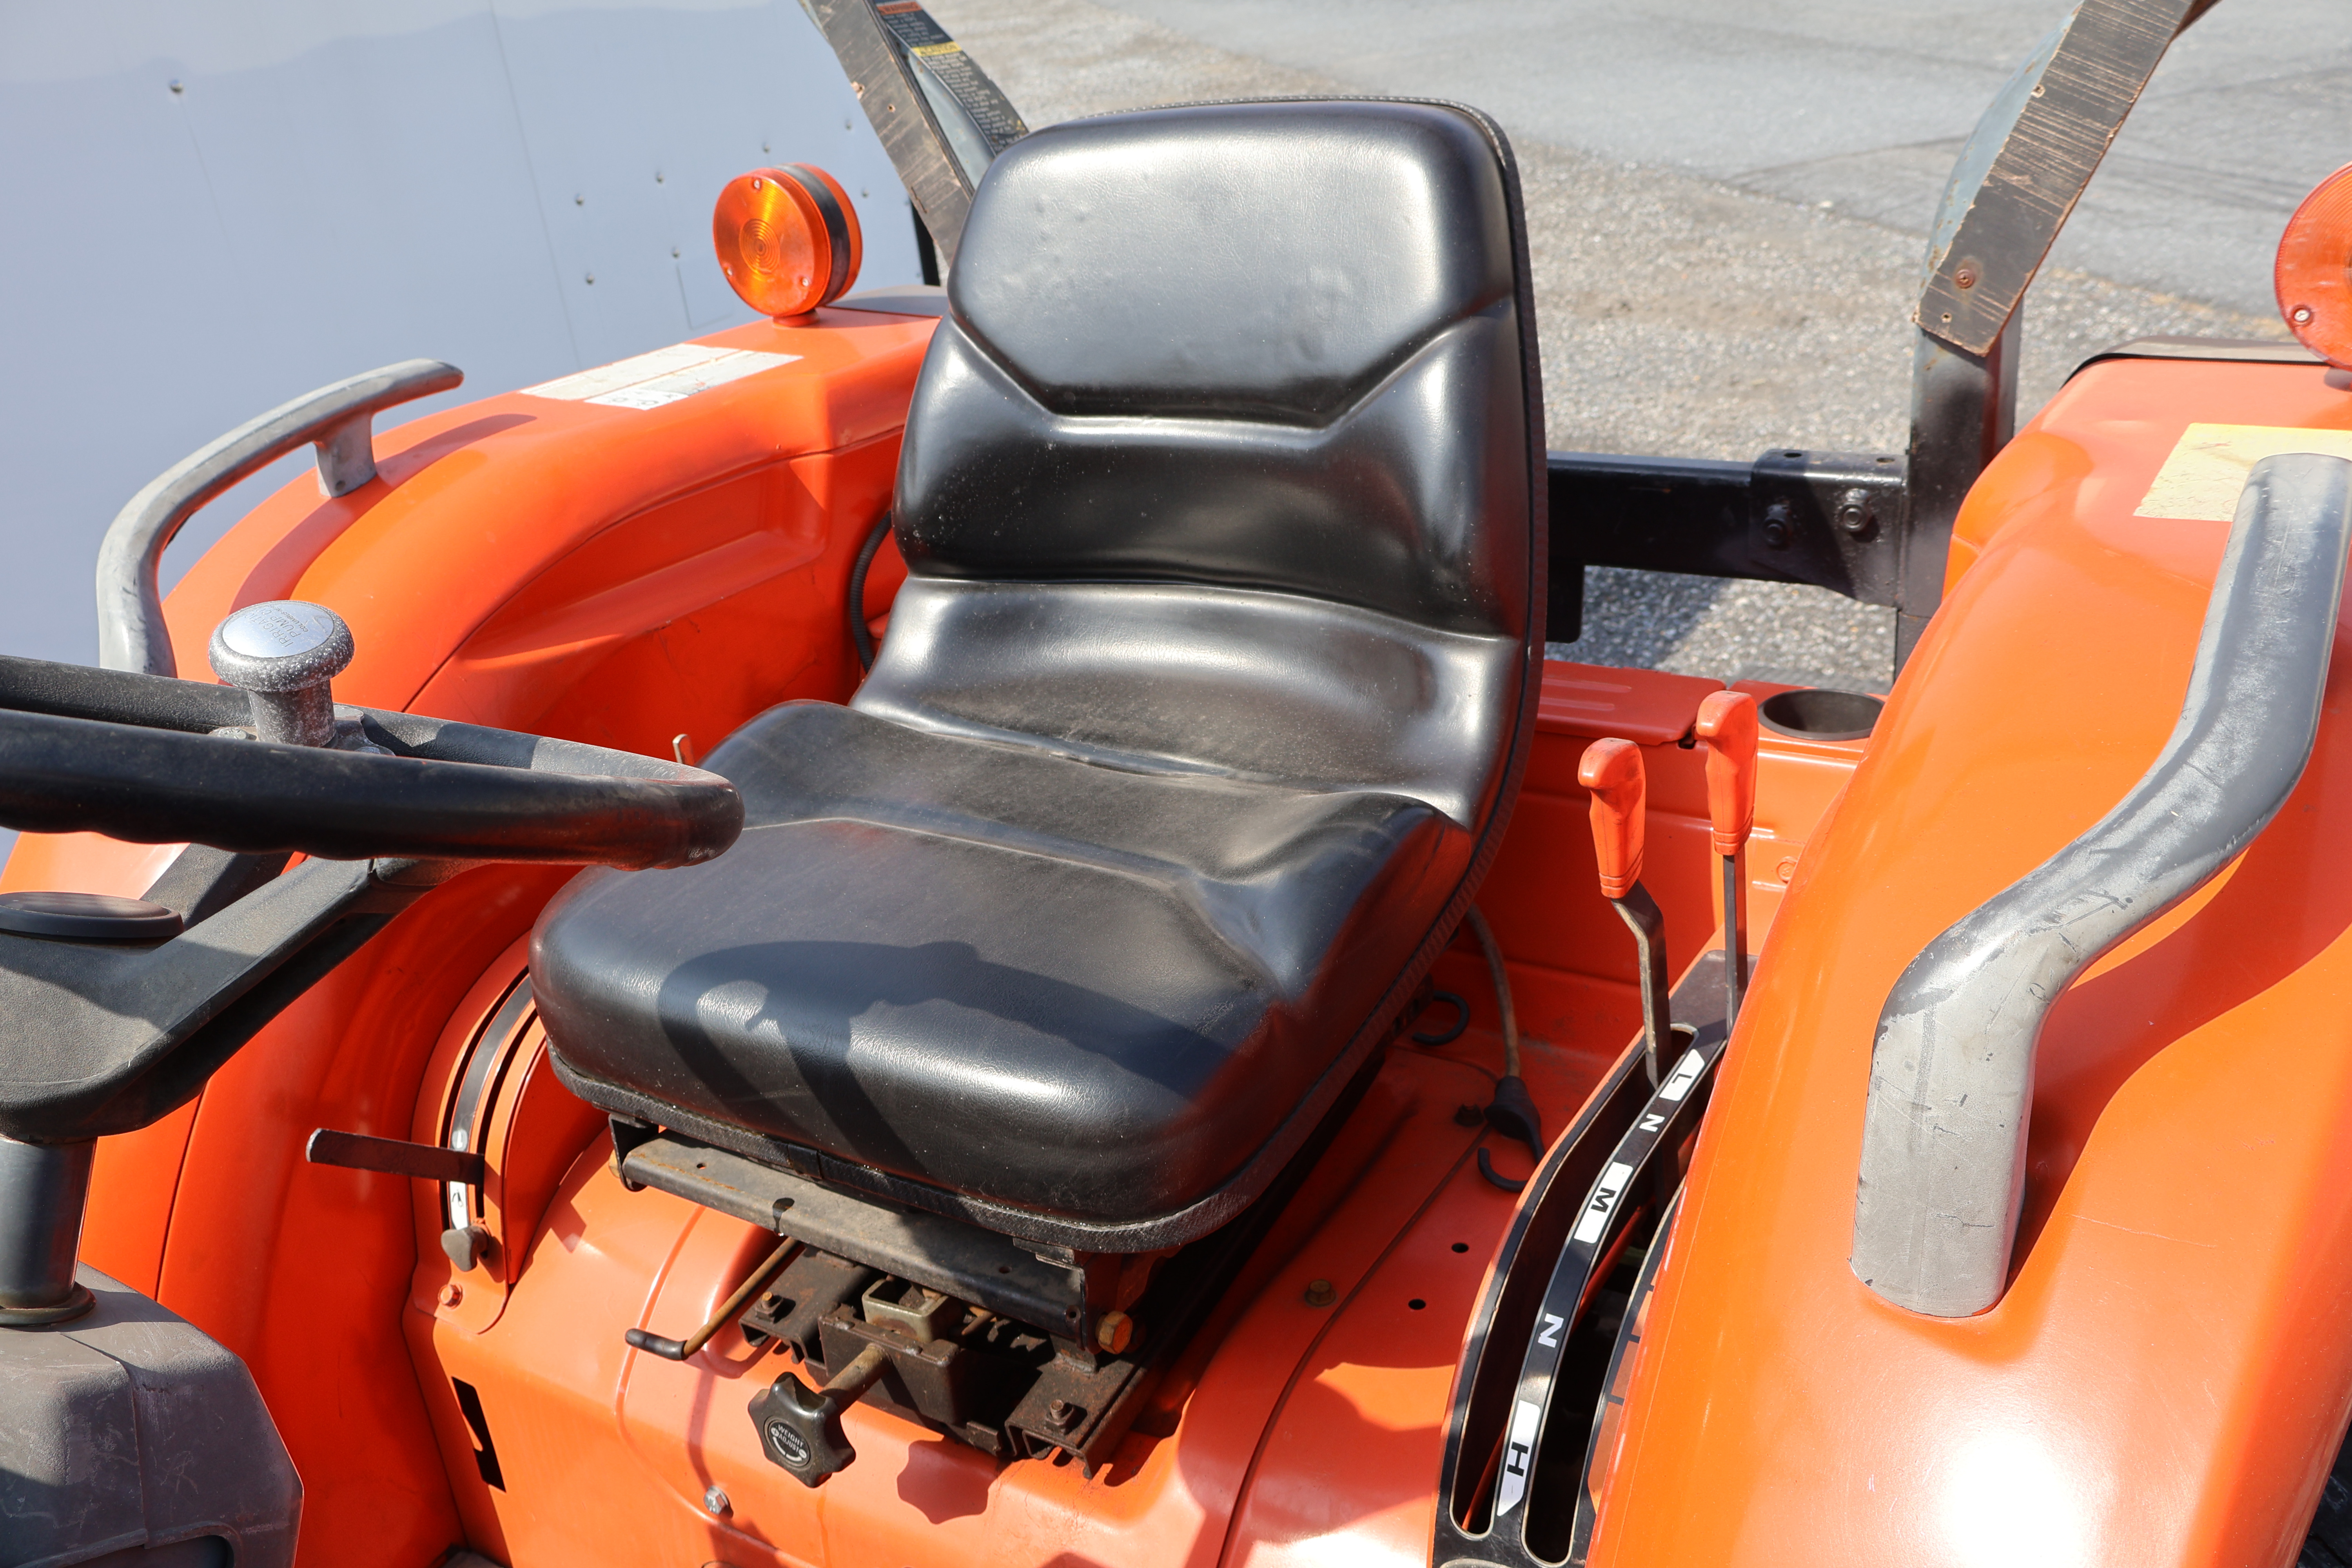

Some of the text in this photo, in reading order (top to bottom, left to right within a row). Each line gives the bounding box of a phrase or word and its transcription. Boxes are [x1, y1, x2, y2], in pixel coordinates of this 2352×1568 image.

[270, 616, 301, 637] PUMP
[1671, 1073, 1692, 1083] L
[1639, 1113, 1665, 1132] N
[1591, 1187, 1617, 1213] M
[1537, 1313, 1564, 1348] N
[778, 1424, 803, 1448] WEIGHT
[779, 1434, 799, 1453] ADJUST
[1507, 1441, 1529, 1477] H
